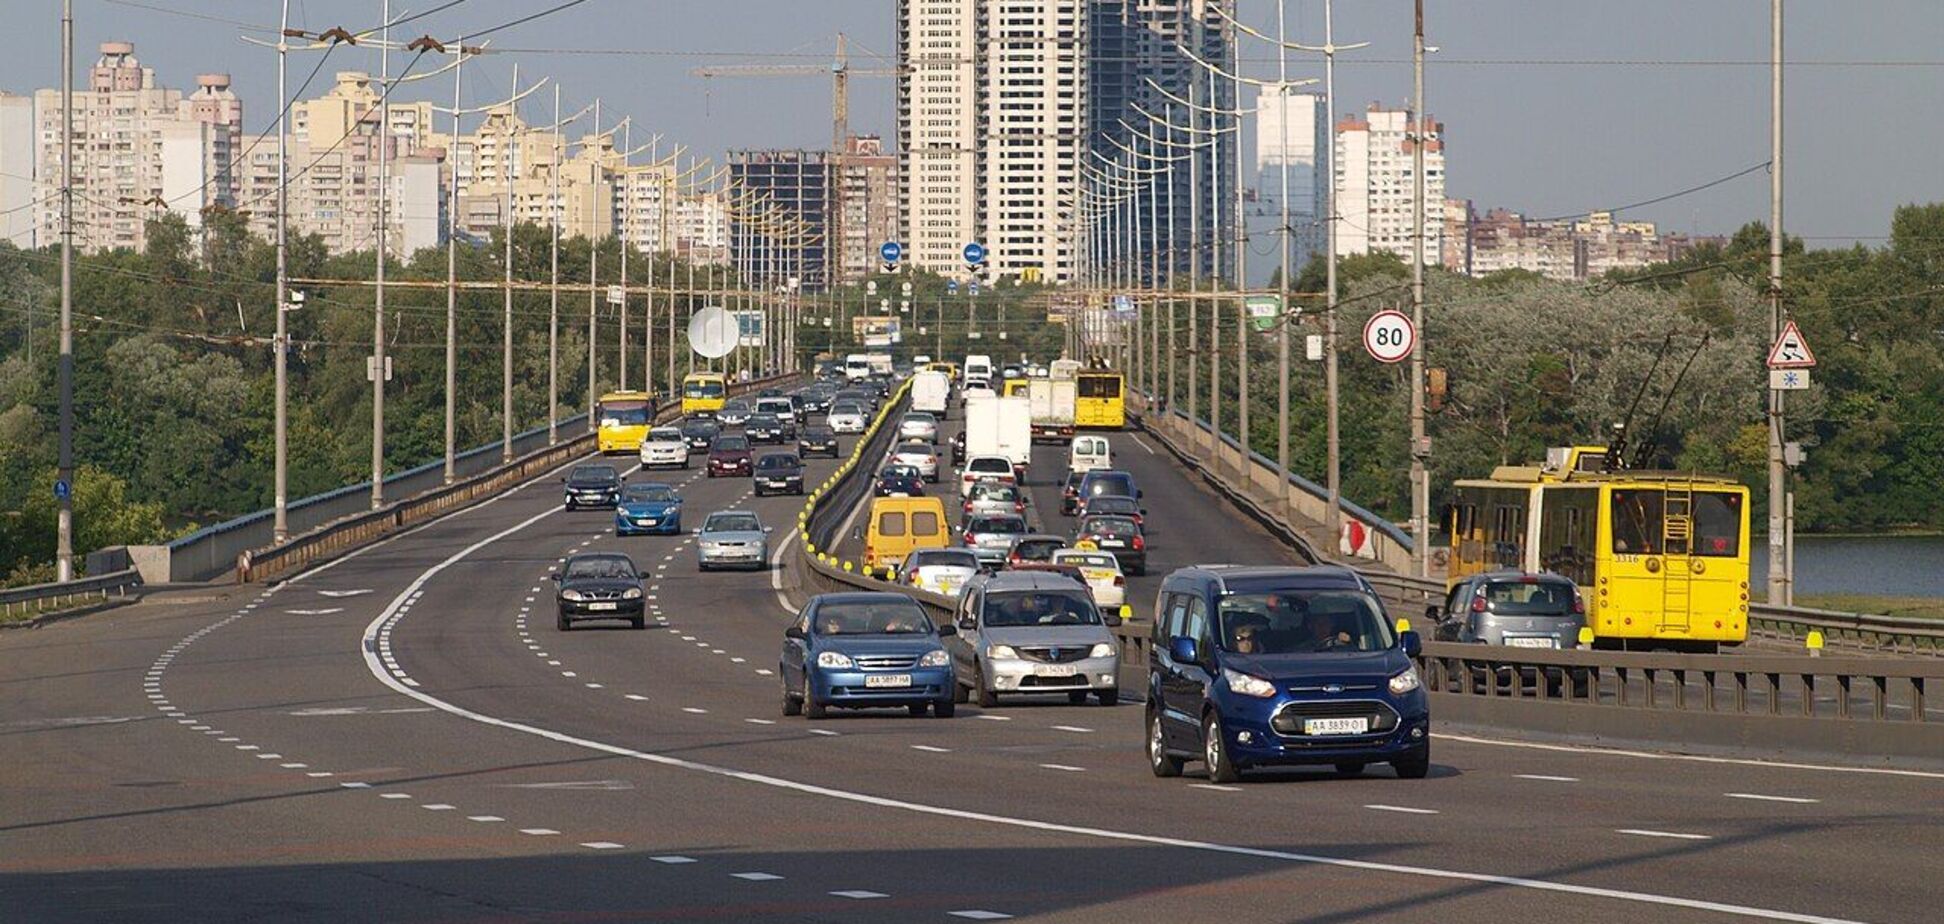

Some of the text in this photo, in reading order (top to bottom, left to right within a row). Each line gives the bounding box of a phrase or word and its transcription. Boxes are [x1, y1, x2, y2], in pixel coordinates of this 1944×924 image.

[1377, 327, 1402, 346] 80
[1615, 554, 1639, 563] 3316
[1312, 721, 1326, 730] AA
[1328, 720, 1349, 730] 3839
